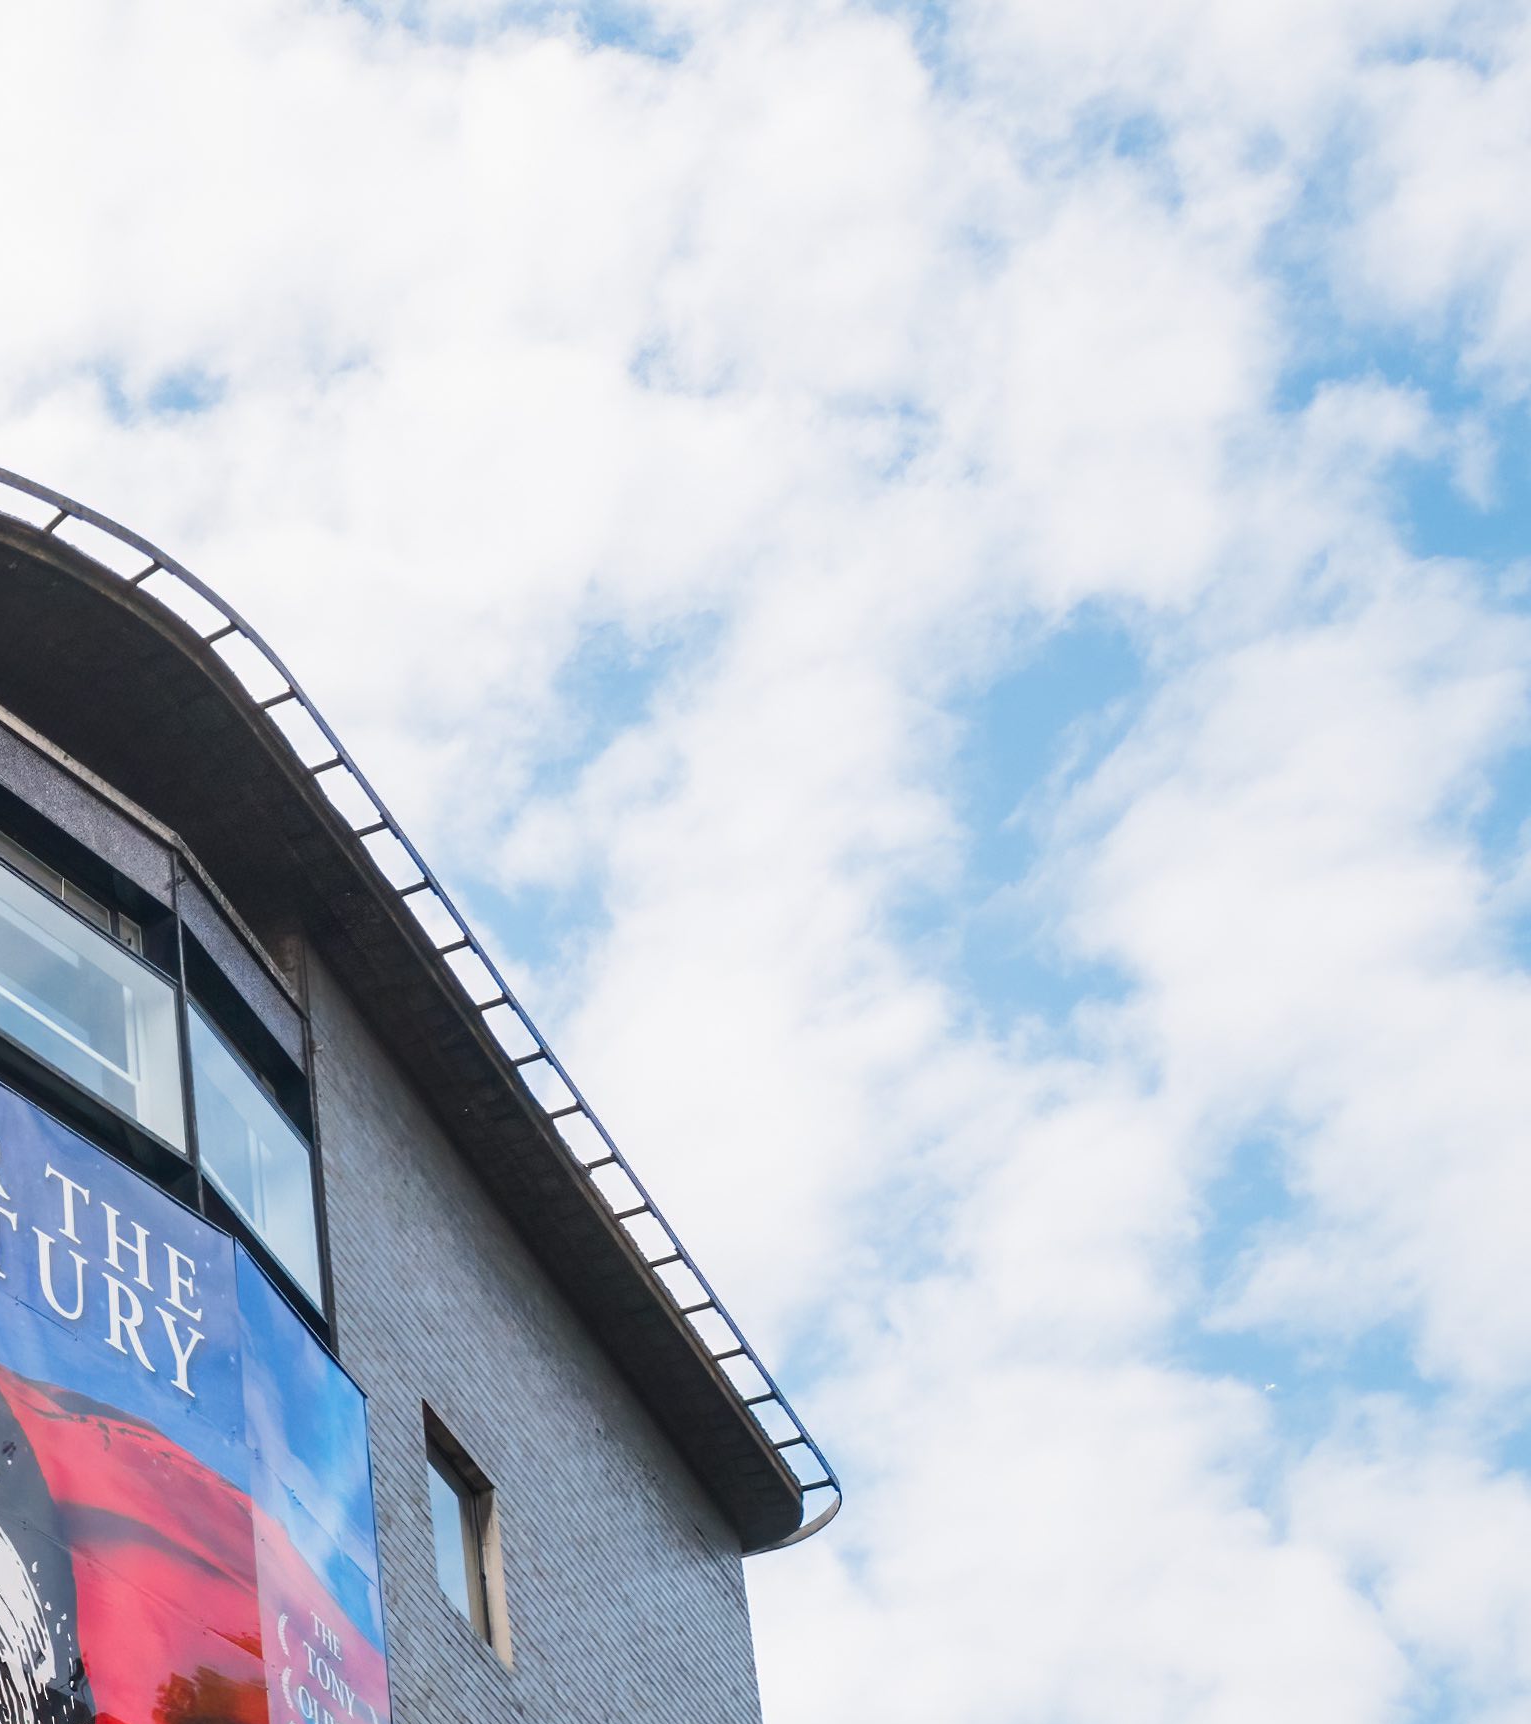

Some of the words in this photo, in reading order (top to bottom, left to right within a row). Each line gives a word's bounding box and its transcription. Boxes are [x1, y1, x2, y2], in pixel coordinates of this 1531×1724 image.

[45, 1163, 203, 1323] THE
[310, 1611, 342, 1661] THE
[303, 1641, 356, 1719] TONY
